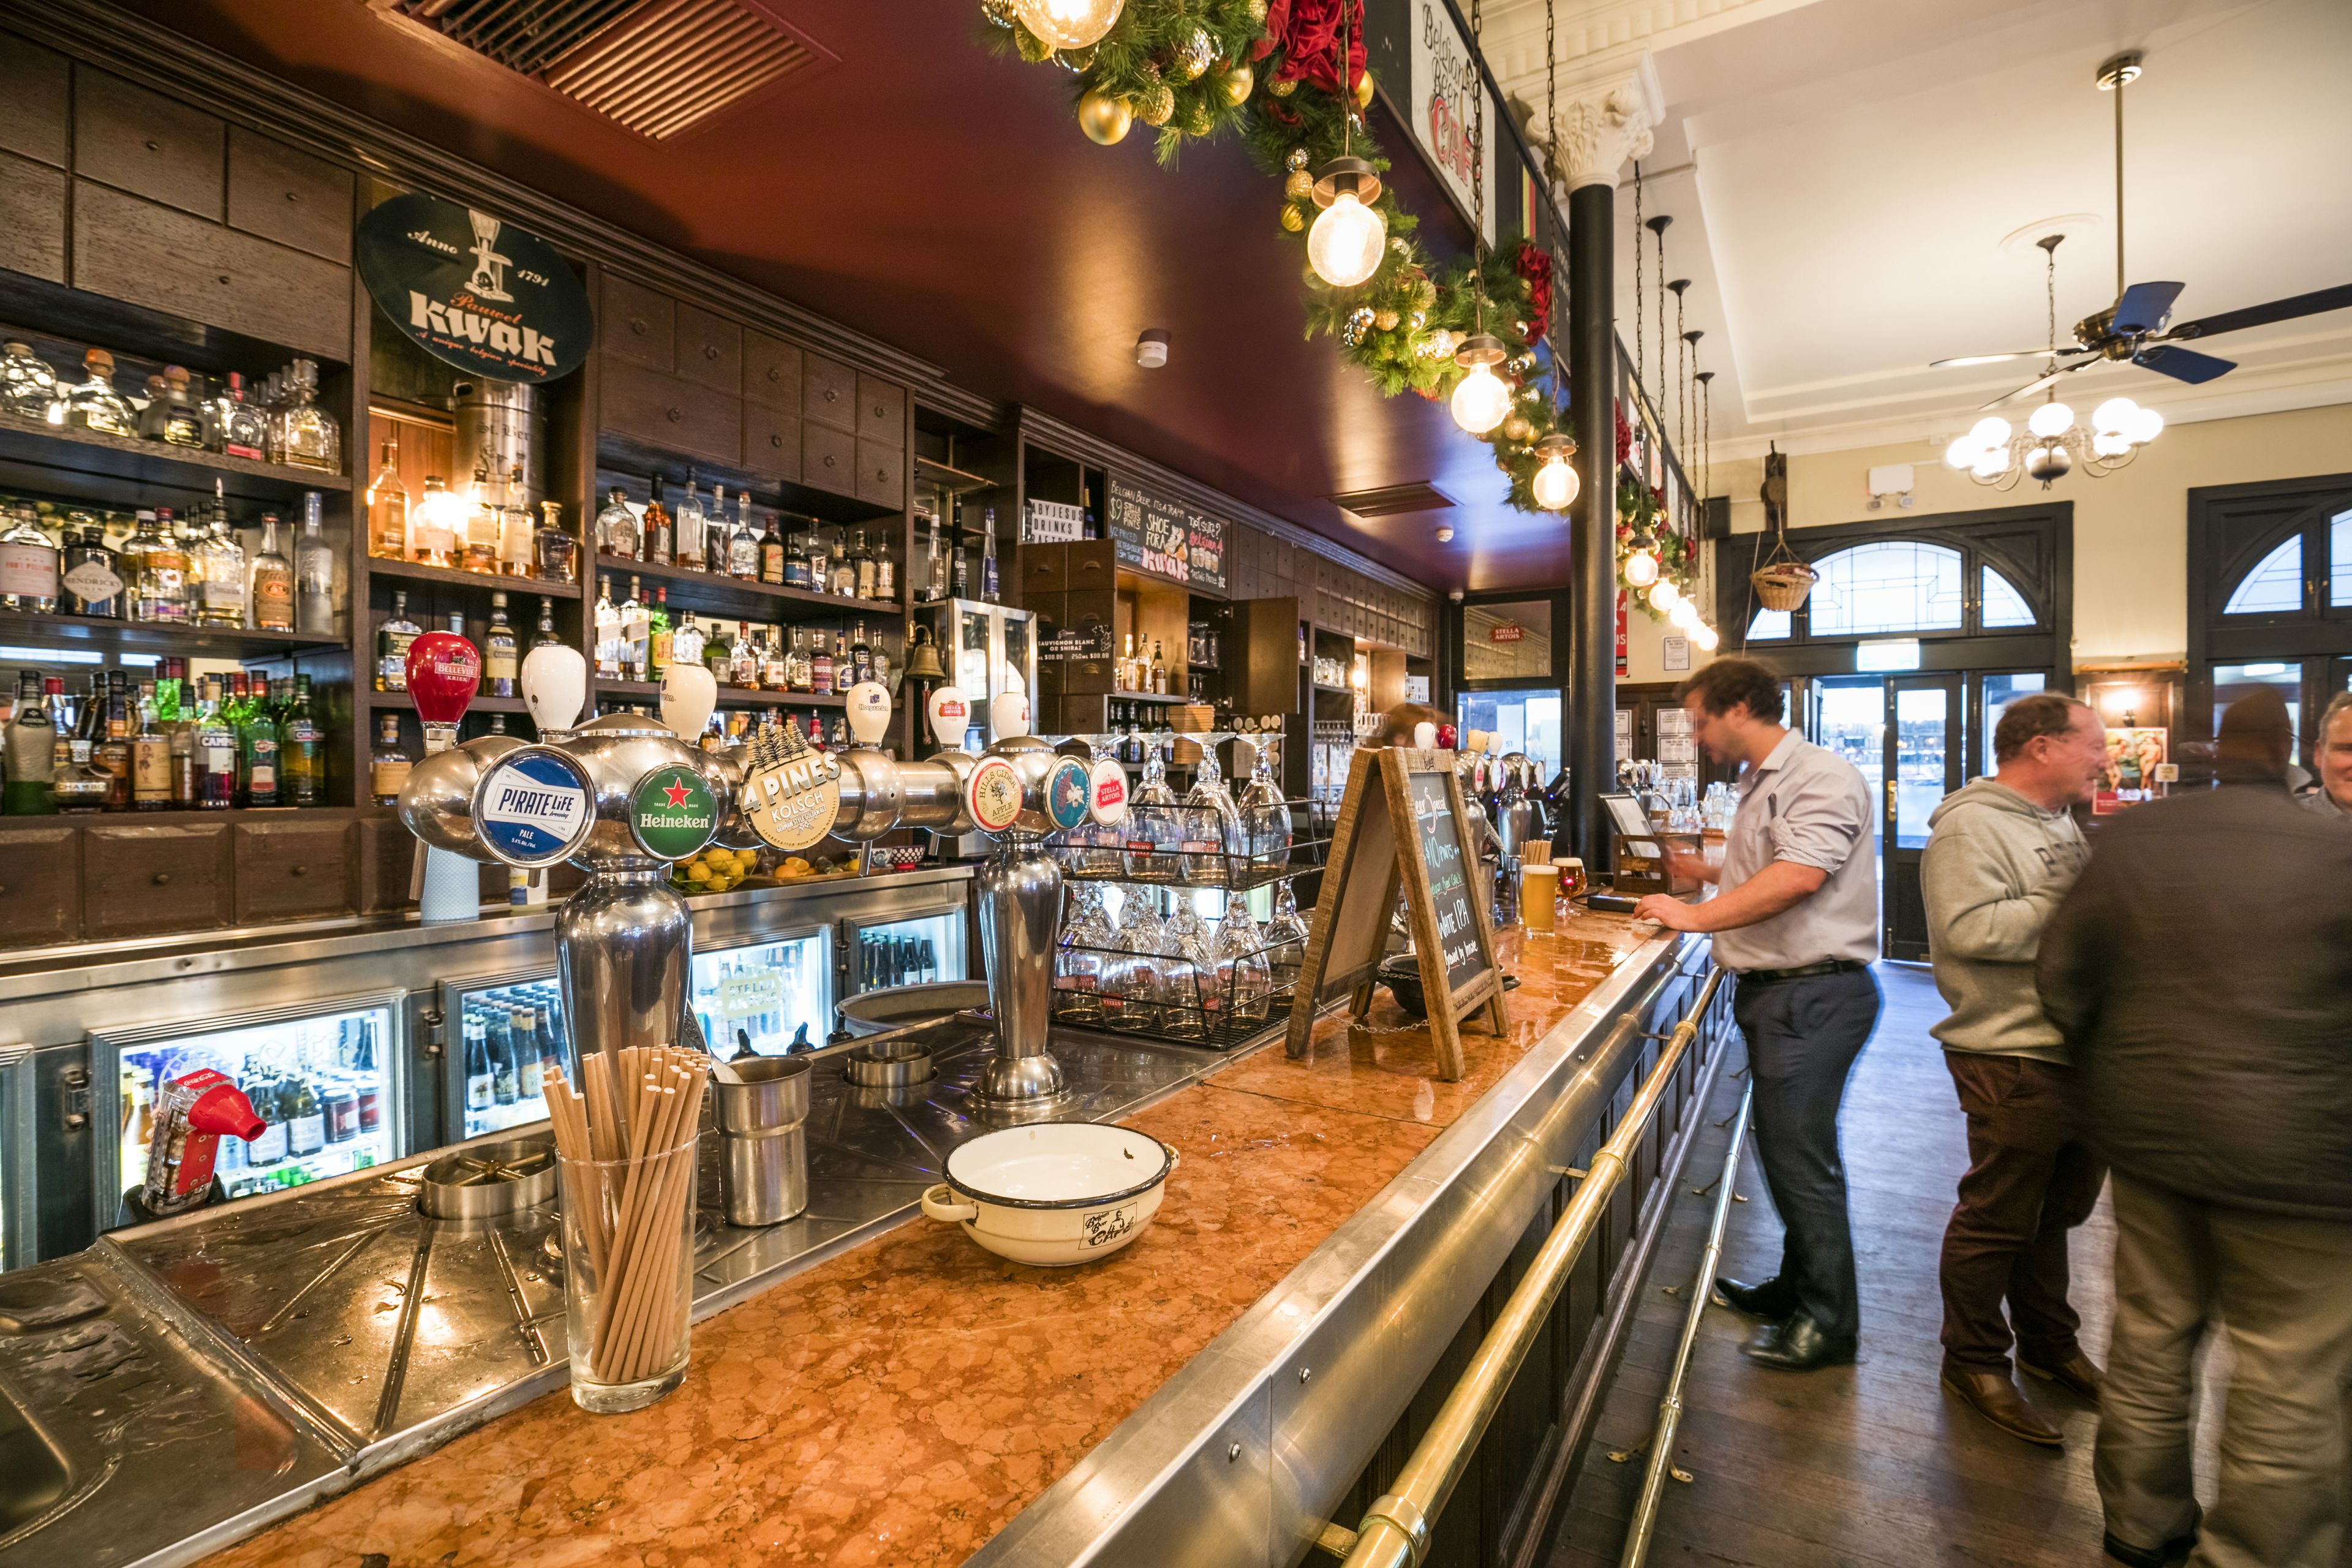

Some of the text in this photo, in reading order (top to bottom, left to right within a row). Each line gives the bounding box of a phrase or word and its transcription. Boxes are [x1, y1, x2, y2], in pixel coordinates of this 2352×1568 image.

[1422, 4, 1464, 86] Belgian
[1431, 56, 1458, 112] Beer
[407, 230, 458, 254] Anno
[503, 424, 531, 441] Ber
[1109, 496, 1123, 520] $9
[1035, 518, 1072, 534] DRINKS
[1123, 518, 1140, 530] PINTS
[1146, 513, 1169, 535] SHOE
[858, 703, 889, 712] Hoegaarden
[744, 752, 841, 813] 4 PINES
[979, 770, 995, 799] HILLS
[996, 769, 1017, 788] CIDER
[1101, 785, 1120, 795] STELLA
[1101, 791, 1121, 803] ARTOIS
[771, 790, 824, 823] KOLSCH
[992, 802, 1013, 816] APPLE
[1415, 799, 1426, 815] eer
[549, 811, 569, 820] brewing
[640, 813, 709, 828] Heineken
[777, 821, 793, 832] GERMAN
[793, 816, 804, 825] STYLE
[519, 829, 534, 840] PALE
[1085, 1212, 1110, 1229] Belgian
